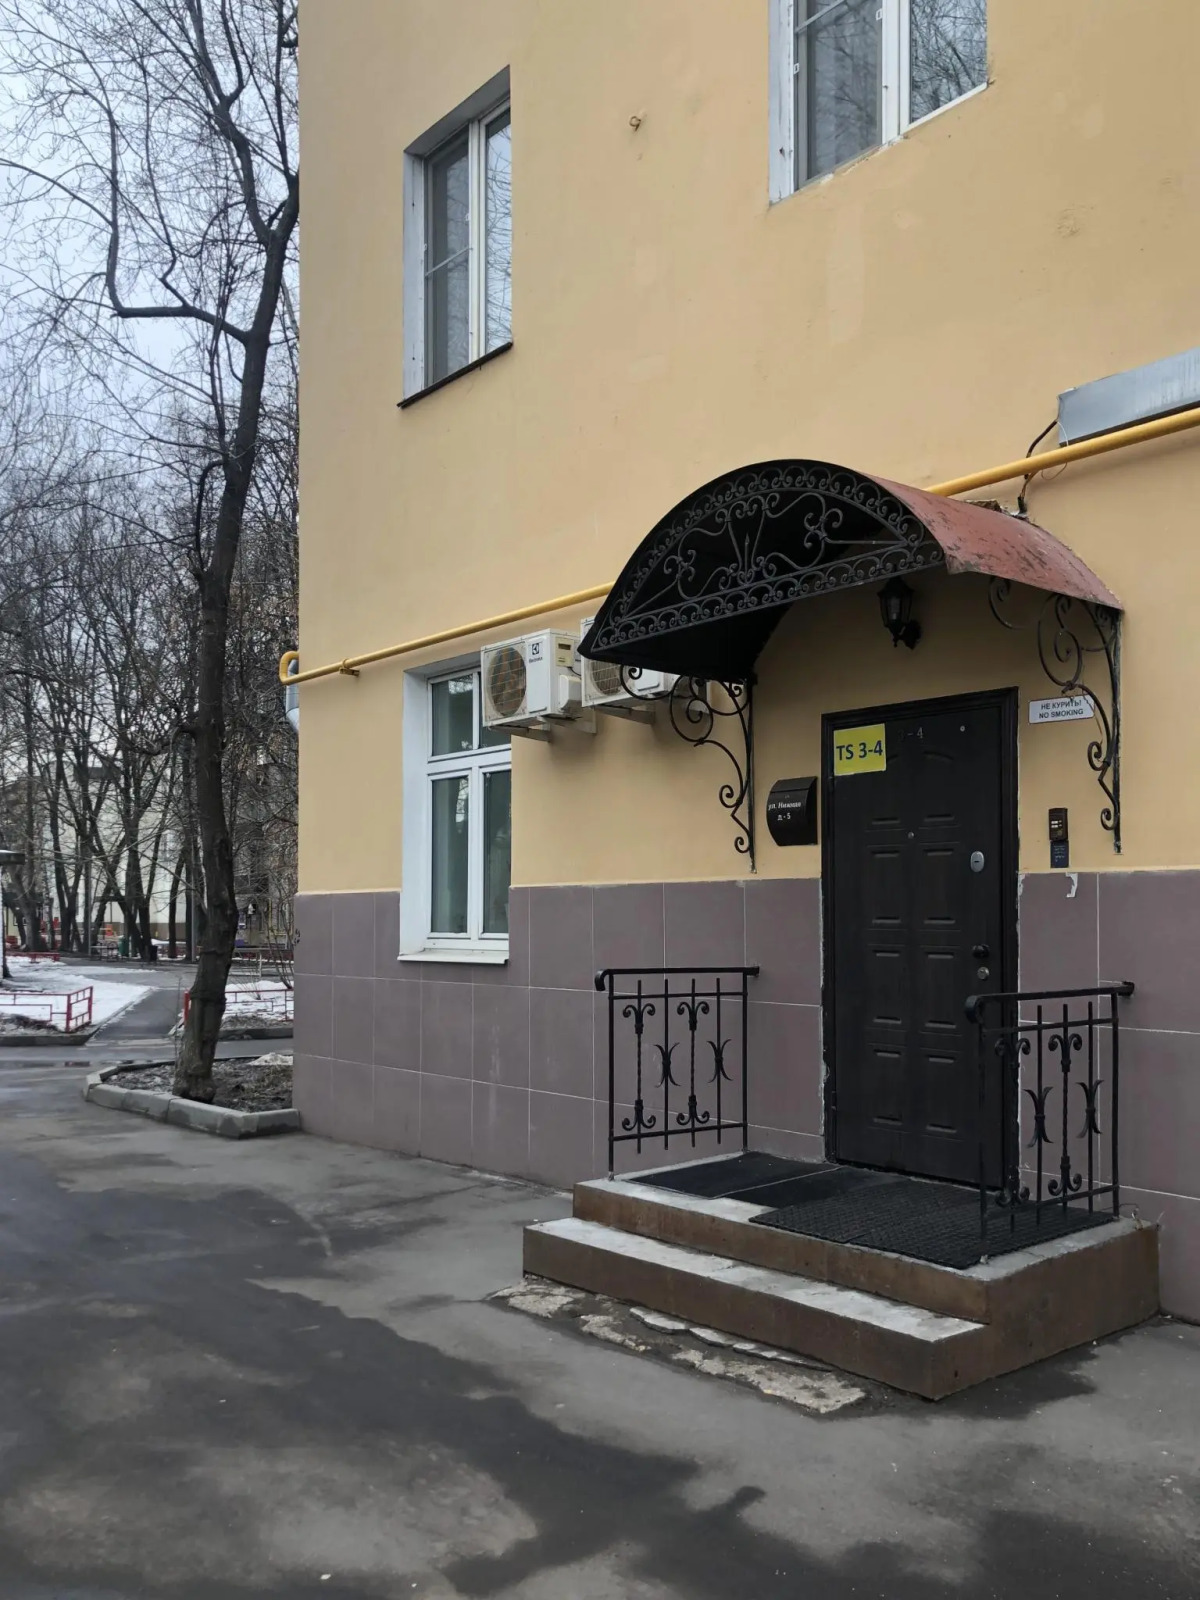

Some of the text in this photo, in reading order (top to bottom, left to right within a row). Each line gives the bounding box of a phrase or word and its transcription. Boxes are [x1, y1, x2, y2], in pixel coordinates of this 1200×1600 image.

[1052, 700, 1081, 708] КУРИТЬ!
[1051, 709, 1083, 717] SMOKING
[836, 740, 883, 761] TS 3-4
